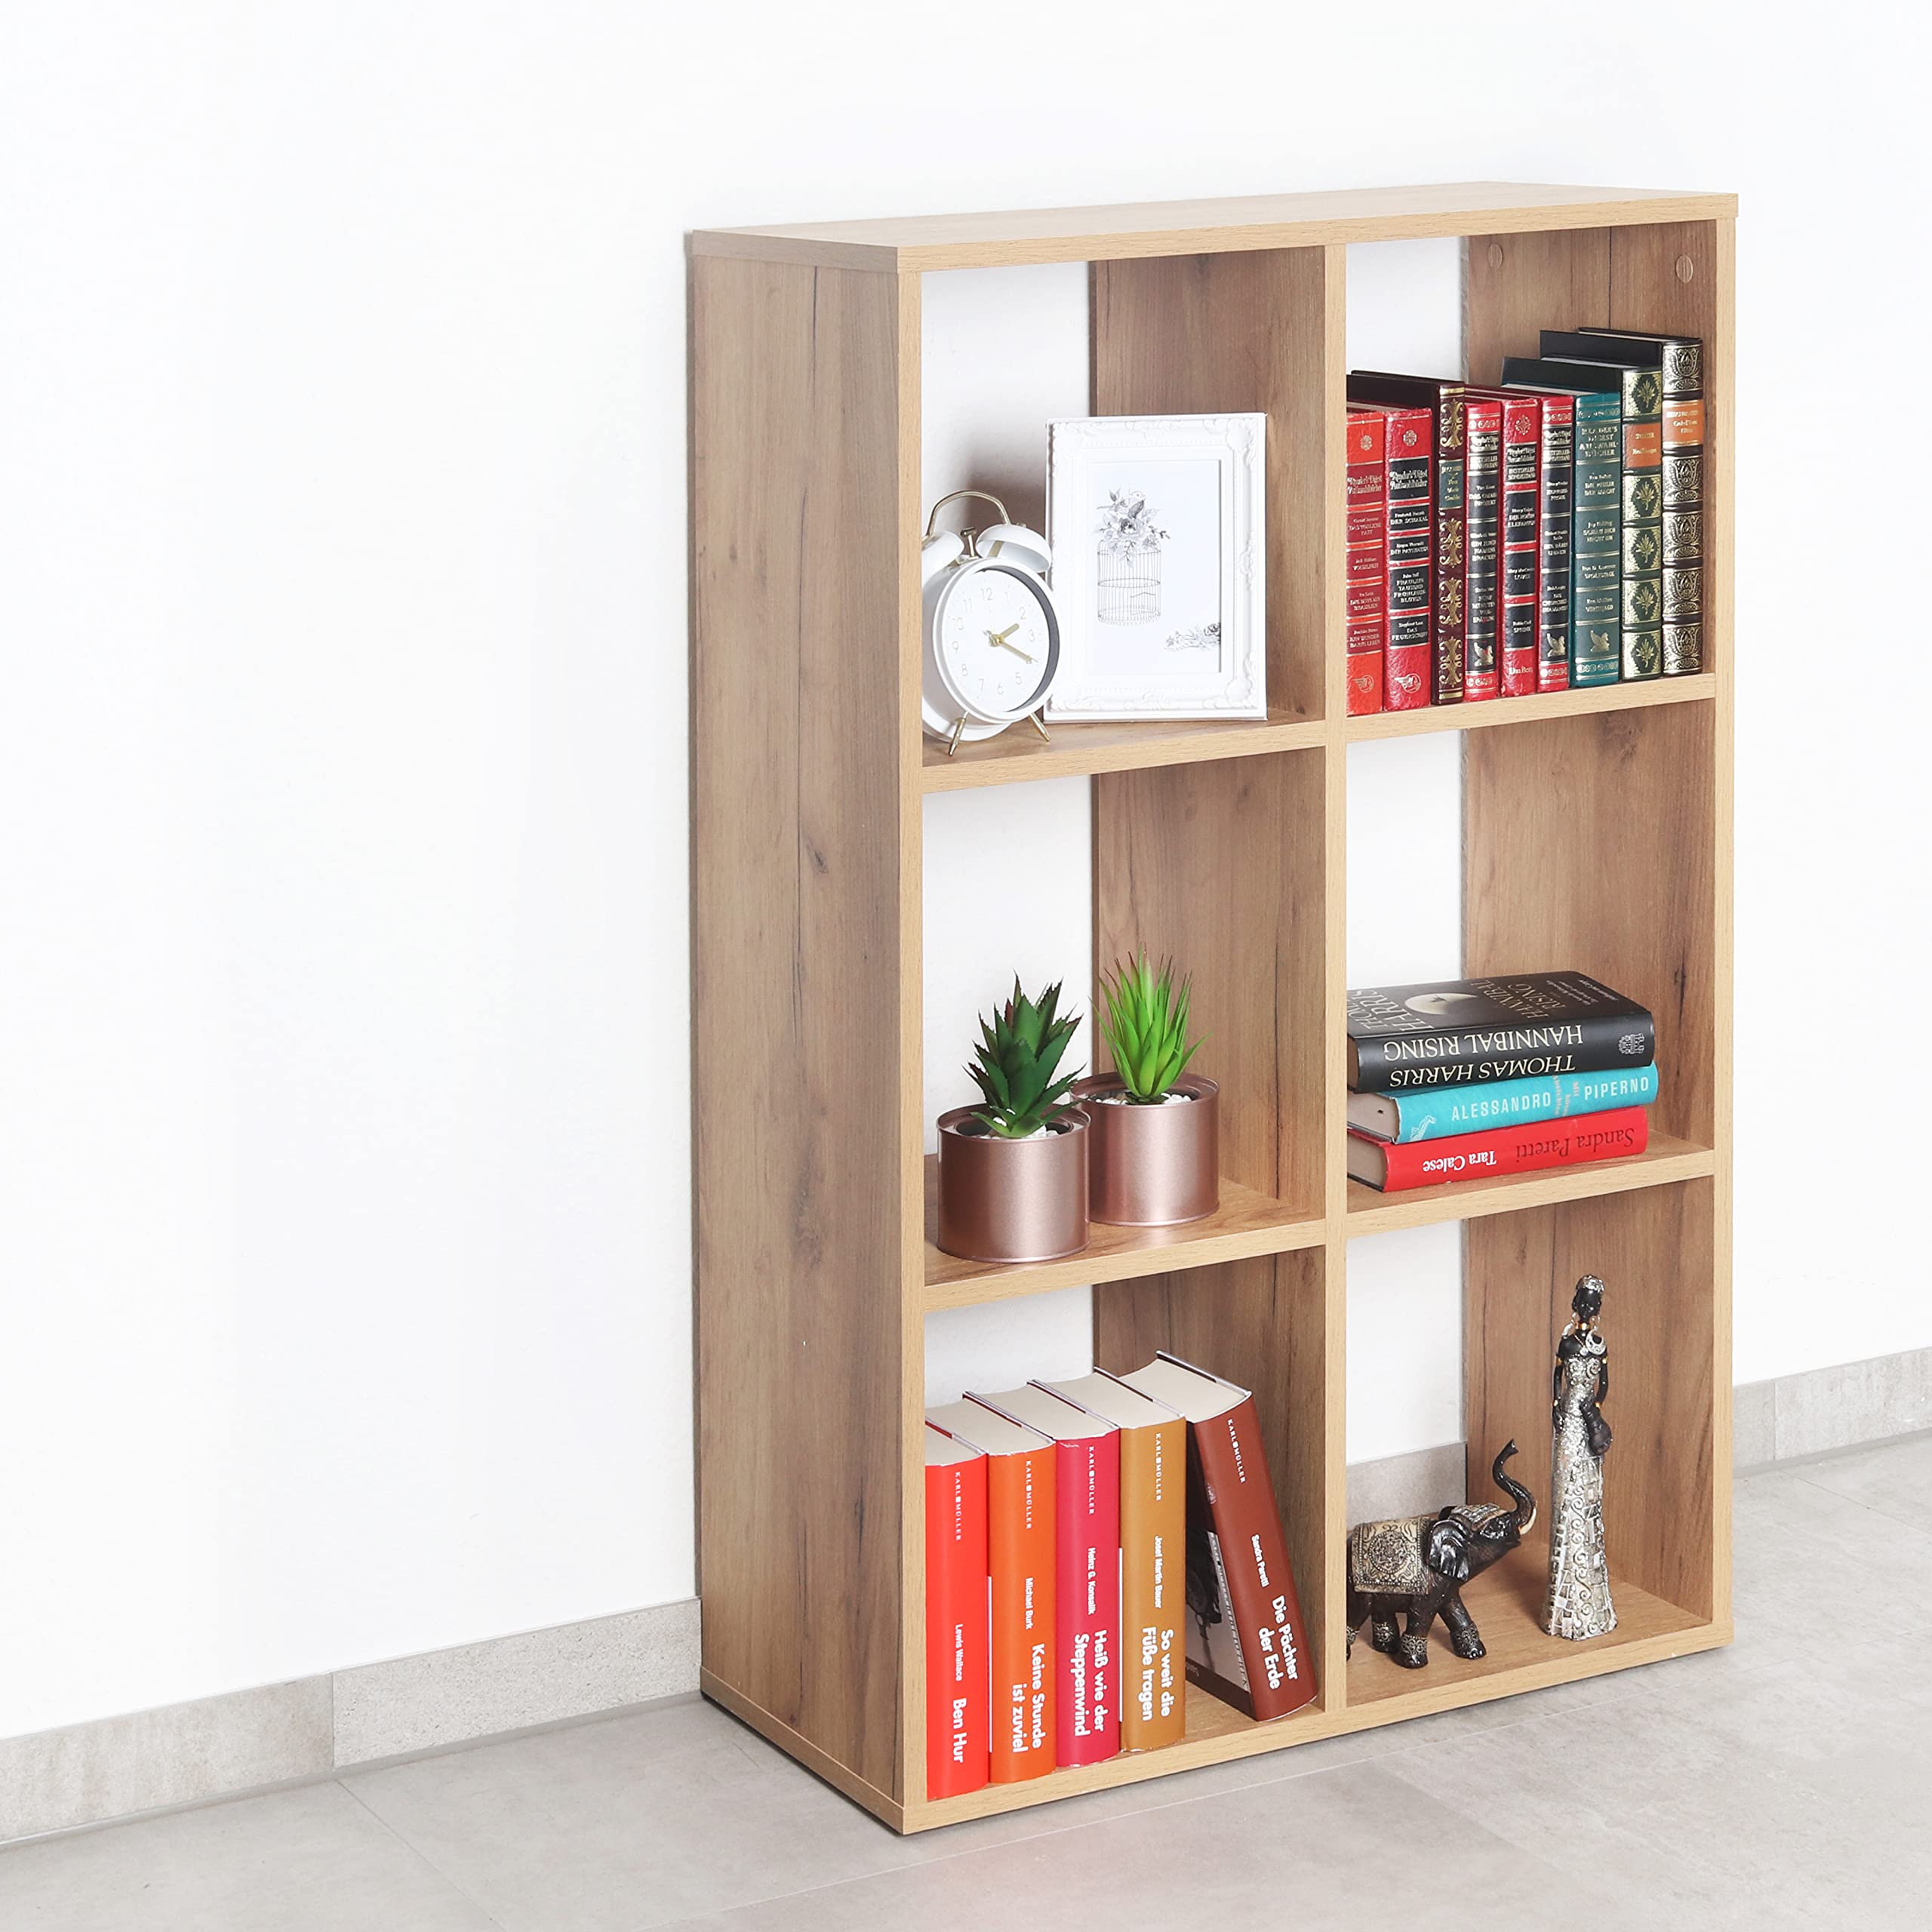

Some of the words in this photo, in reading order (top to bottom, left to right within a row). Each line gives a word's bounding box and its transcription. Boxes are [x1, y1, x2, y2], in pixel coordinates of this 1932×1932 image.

[981, 587, 993, 601] 12
[954, 617, 964, 631] 10
[1020, 607, 1026, 620] 2
[952, 641, 959, 654] 9
[1028, 629, 1035, 642] 3
[961, 664, 968, 676] 8
[1015, 672, 1022, 685] 5
[978, 678, 984, 691] 7
[997, 682, 1004, 695] 6
[1472, 980, 1550, 1019] HANNIBAL
[1508, 983, 1567, 1010] RISING
[1347, 996, 1388, 1030] THOM
[1352, 990, 1434, 1032] HARRIS
[1383, 1035, 1461, 1062] RISING
[1463, 1024, 1583, 1054] HANNIBAL
[1389, 1064, 1475, 1088] HARRIS
[1478, 1055, 1577, 1079] THOMAS
[1451, 1092, 1552, 1121] ALESSANDRO
[1584, 1076, 1650, 1101] PIPERNO
[1515, 1138, 1570, 1163] Paretti
[1576, 1128, 1635, 1153] Sandra
[1423, 1155, 1466, 1173] Calese
[1469, 1151, 1497, 1166] Tara
[1227, 1419, 1237, 1442] KARL
[1088, 1547, 1096, 1570] Heinz
[1155, 1536, 1163, 1557] Josef
[1155, 1558, 1163, 1584] Martin
[1251, 1534, 1263, 1563] Sandra
[1257, 1561, 1270, 1588] Paretti
[1025, 1577, 1034, 1608] Michael
[1088, 1580, 1096, 1615] Konsalik
[1155, 1584, 1163, 1608] Bauer
[1025, 1610, 1034, 1630] Burk
[1272, 1595, 1287, 1624] Die
[955, 1623, 964, 1648] Lewis
[1142, 1626, 1158, 1666] Füße
[1161, 1629, 1174, 1651] So
[1258, 1627, 1275, 1653] der
[1094, 1629, 1109, 1669] Heiß
[1278, 1623, 1298, 1680] Pächter
[955, 1649, 964, 1681] Wallace
[1032, 1643, 1045, 1690] Keine
[1161, 1653, 1174, 1688] weit
[1265, 1653, 1284, 1690] Erde
[1012, 1683, 1027, 1703] ist
[1070, 1633, 1091, 1737] Steppenwind
[1094, 1671, 1107, 1701] wie
[1137, 1669, 1155, 1721] tragen
[952, 1697, 967, 1729] Ben
[1161, 1691, 1175, 1717] die
[1012, 1706, 1029, 1753] zuviel
[1032, 1693, 1046, 1749] Stunde
[1094, 1705, 1109, 1732] der
[953, 1732, 968, 1763] Hur
